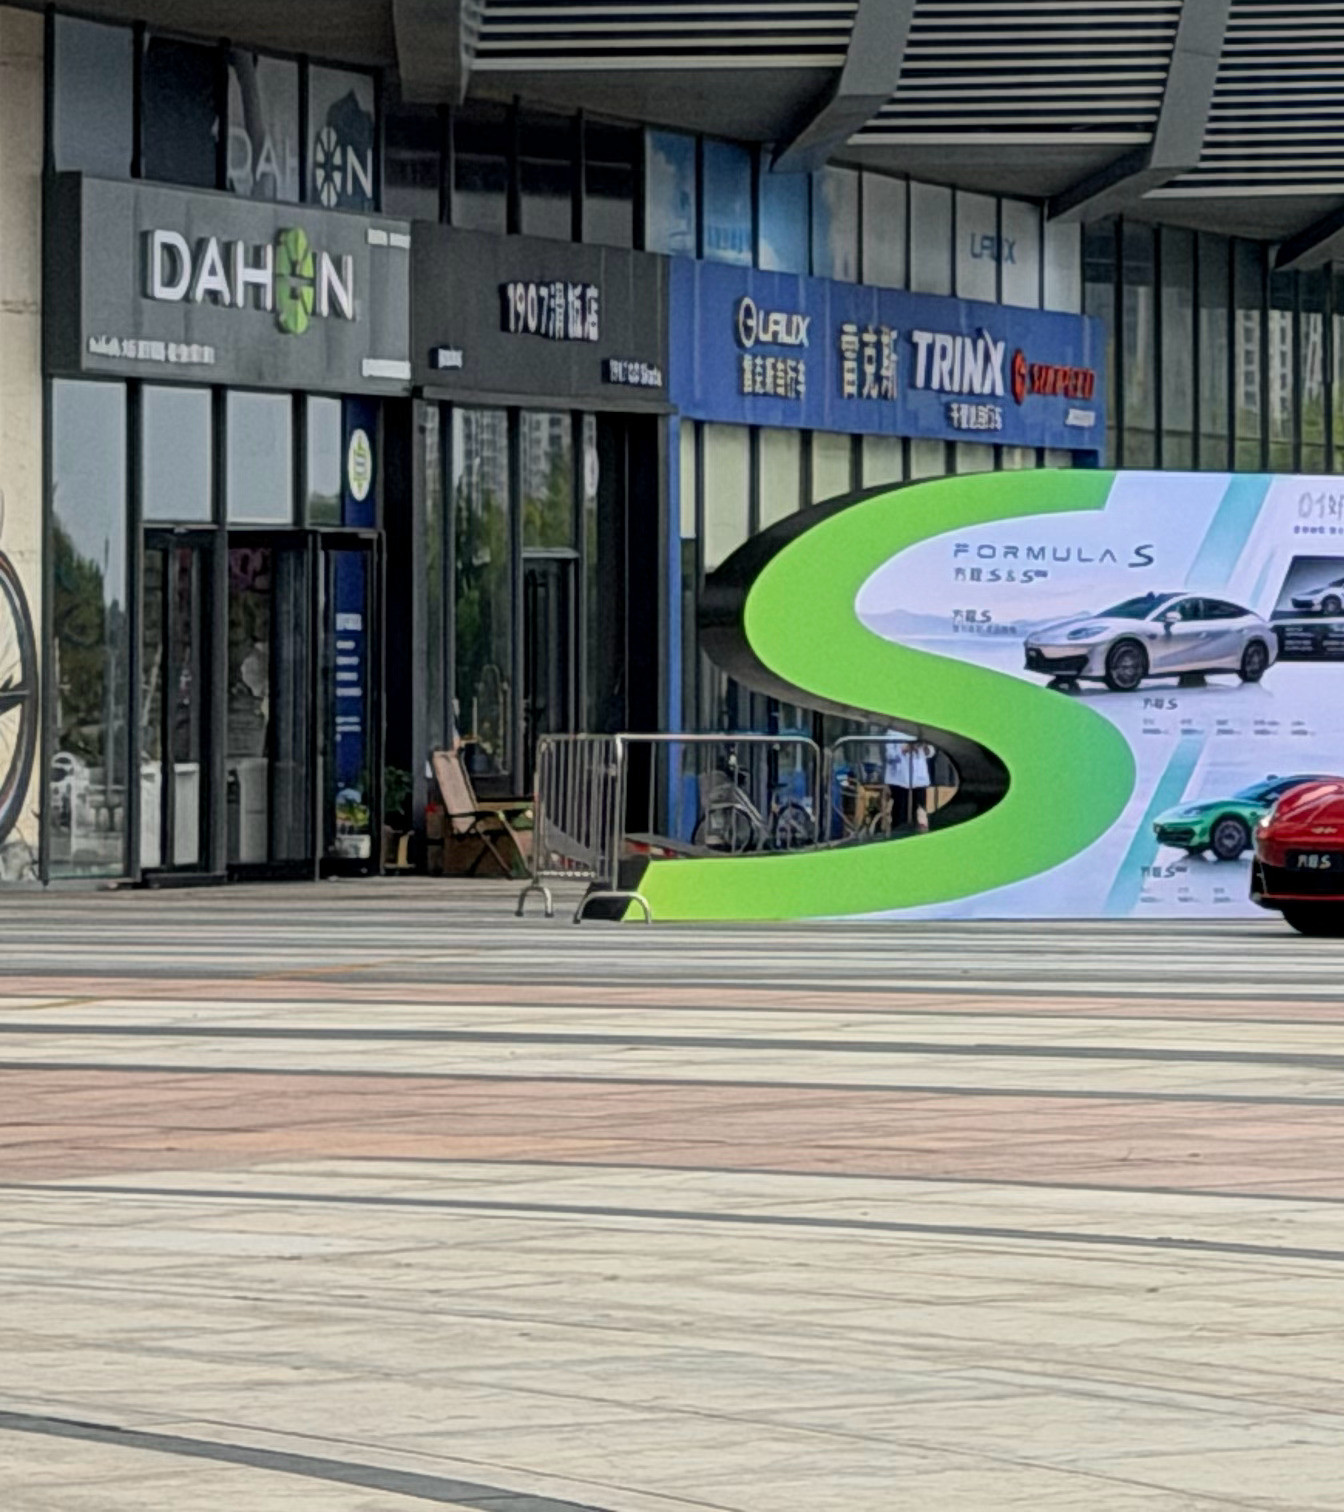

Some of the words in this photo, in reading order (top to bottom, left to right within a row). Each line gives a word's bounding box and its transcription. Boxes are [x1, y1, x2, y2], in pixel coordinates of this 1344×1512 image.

[146, 226, 356, 336] DAHON
[970, 232, 1017, 265] LAX
[840, 323, 899, 400] 雷克斯
[911, 327, 1006, 397] TRINX
[953, 543, 1118, 564] FORMULA
